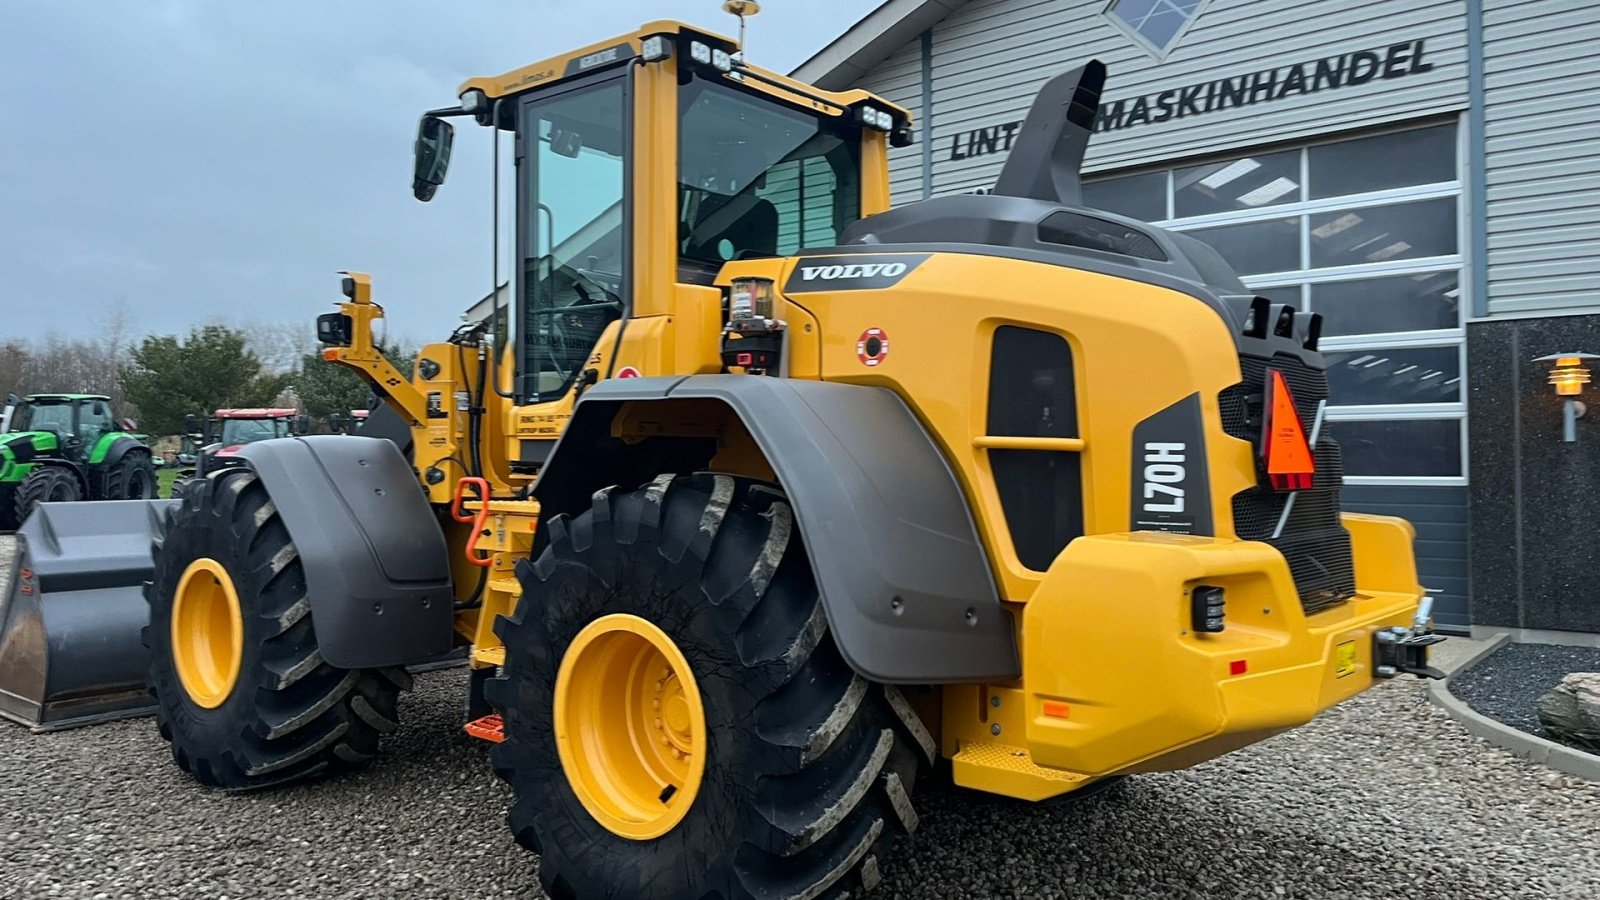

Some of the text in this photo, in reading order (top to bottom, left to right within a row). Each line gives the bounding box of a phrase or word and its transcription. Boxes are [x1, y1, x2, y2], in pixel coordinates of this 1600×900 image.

[951, 40, 1434, 161] LINT MASKINHANDEL
[800, 262, 907, 281] VOLVO
[1143, 442, 1186, 513] L70H
